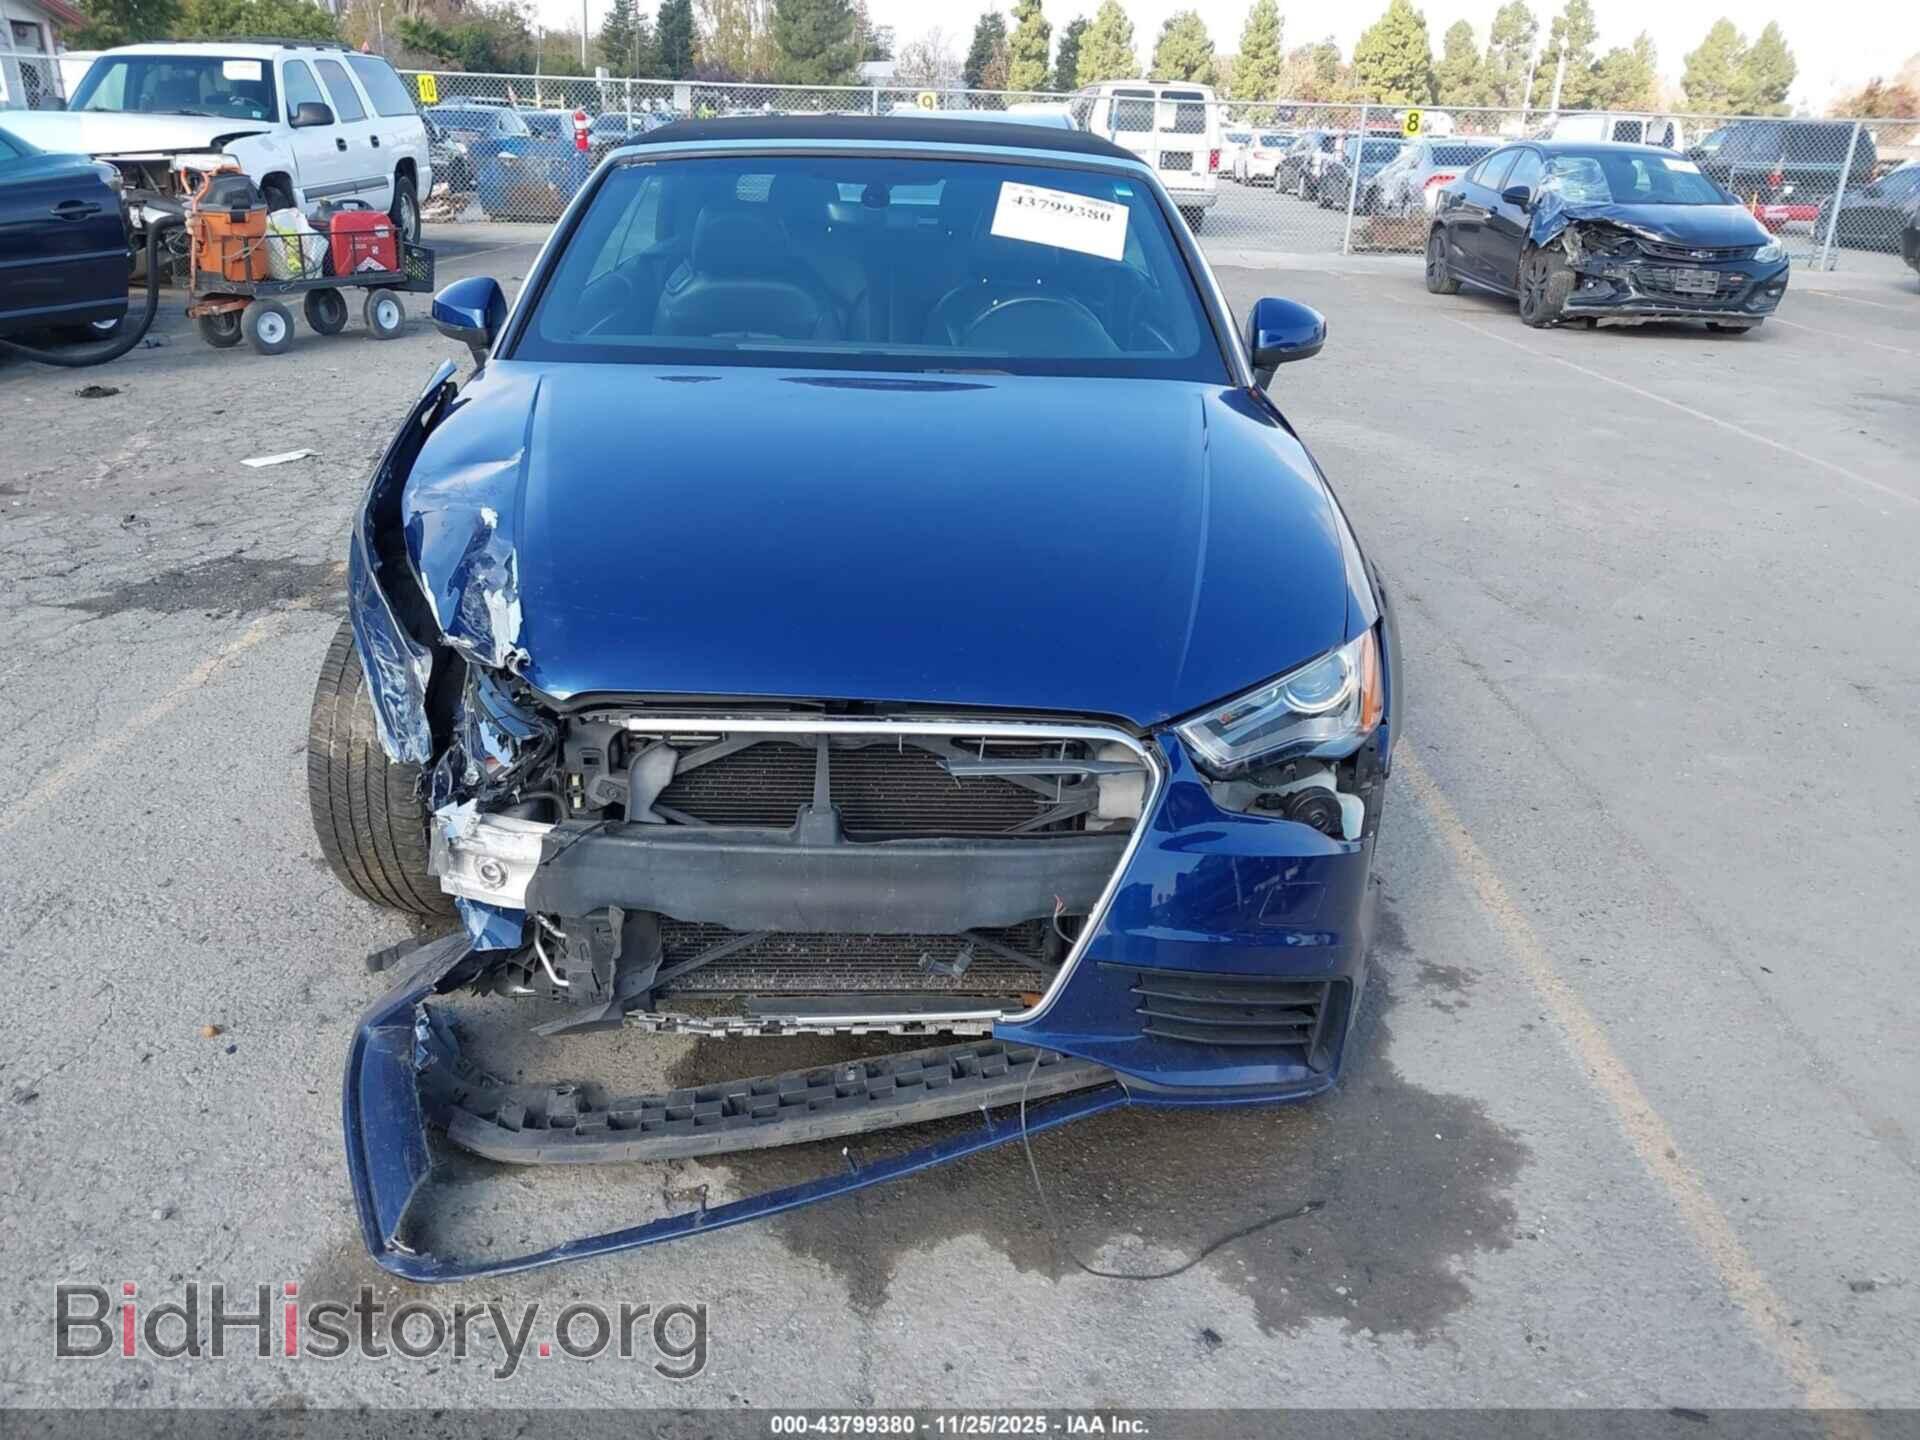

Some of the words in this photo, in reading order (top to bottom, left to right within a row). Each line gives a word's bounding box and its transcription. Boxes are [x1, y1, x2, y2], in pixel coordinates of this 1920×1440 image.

[421, 78, 435, 97] 10
[922, 95, 934, 110] 9
[1407, 112, 1419, 132] 8
[1011, 195, 1112, 222] 43799380
